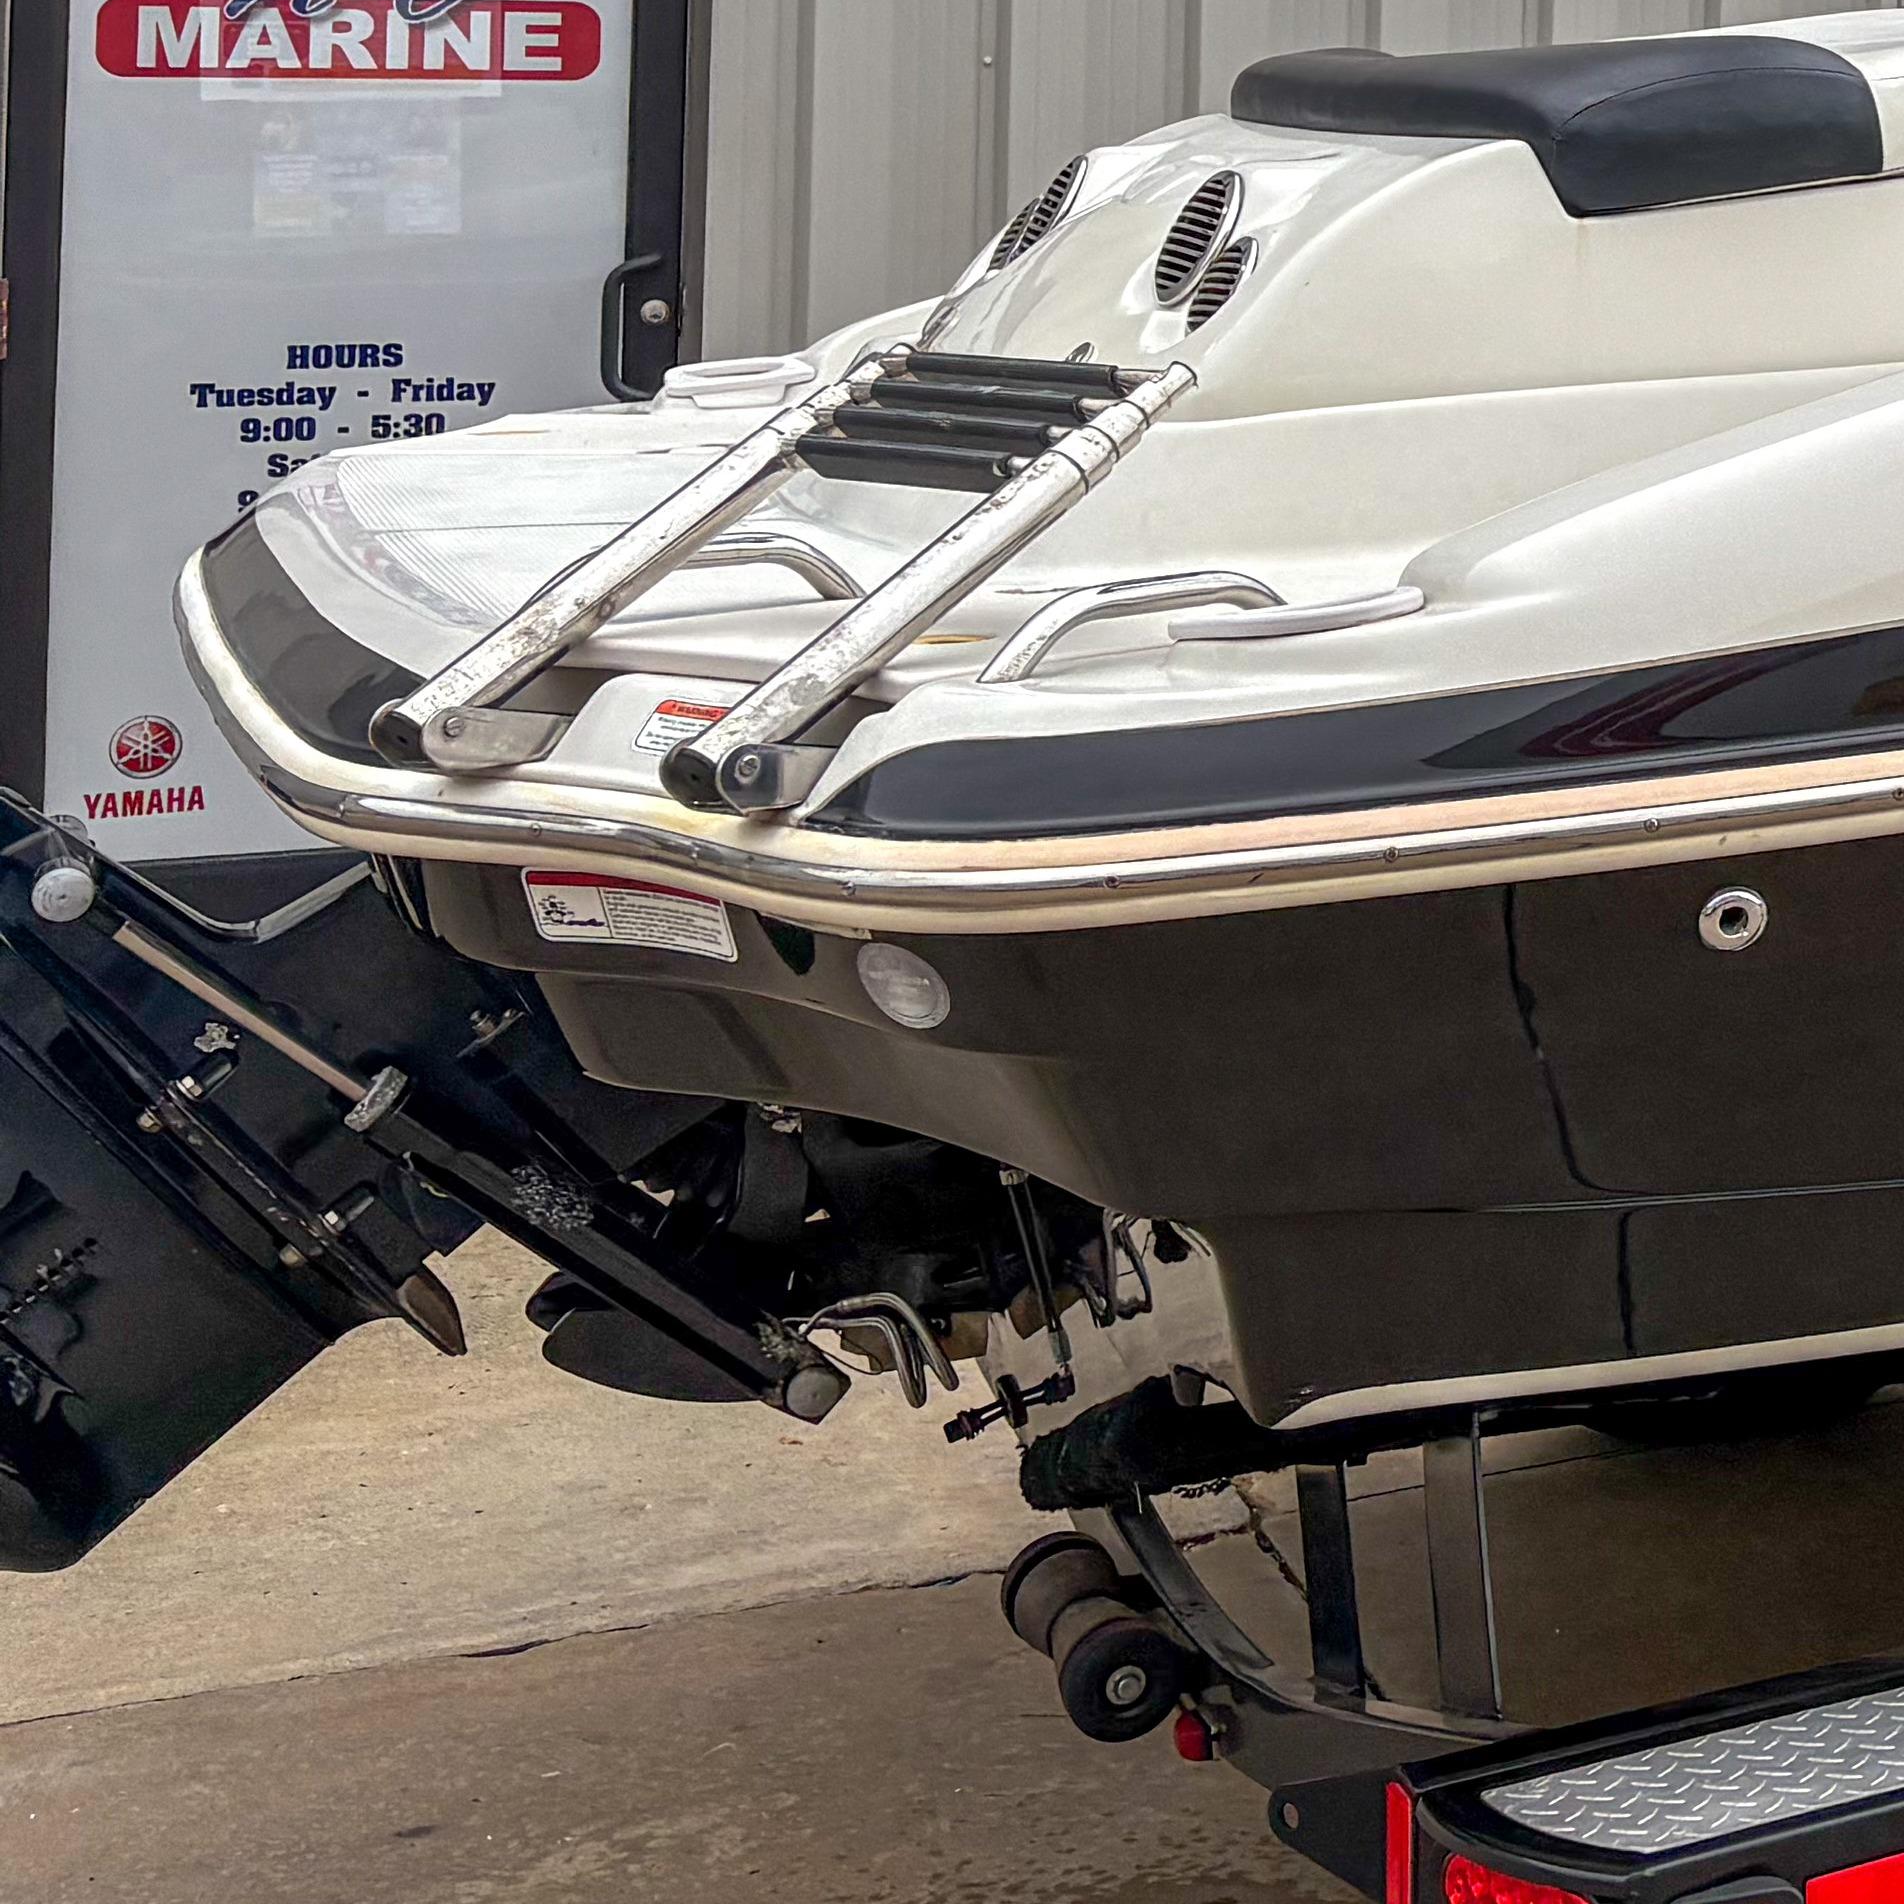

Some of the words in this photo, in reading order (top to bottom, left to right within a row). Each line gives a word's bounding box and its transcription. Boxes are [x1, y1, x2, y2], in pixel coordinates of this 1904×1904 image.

[136, 5, 562, 72] MARINE
[286, 343, 403, 370] HOURS
[190, 381, 337, 411] Tuesday
[391, 377, 497, 406] Friday
[240, 417, 317, 443] 9:00
[371, 413, 446, 439] 5:30
[83, 785, 205, 819] YAMAHA
